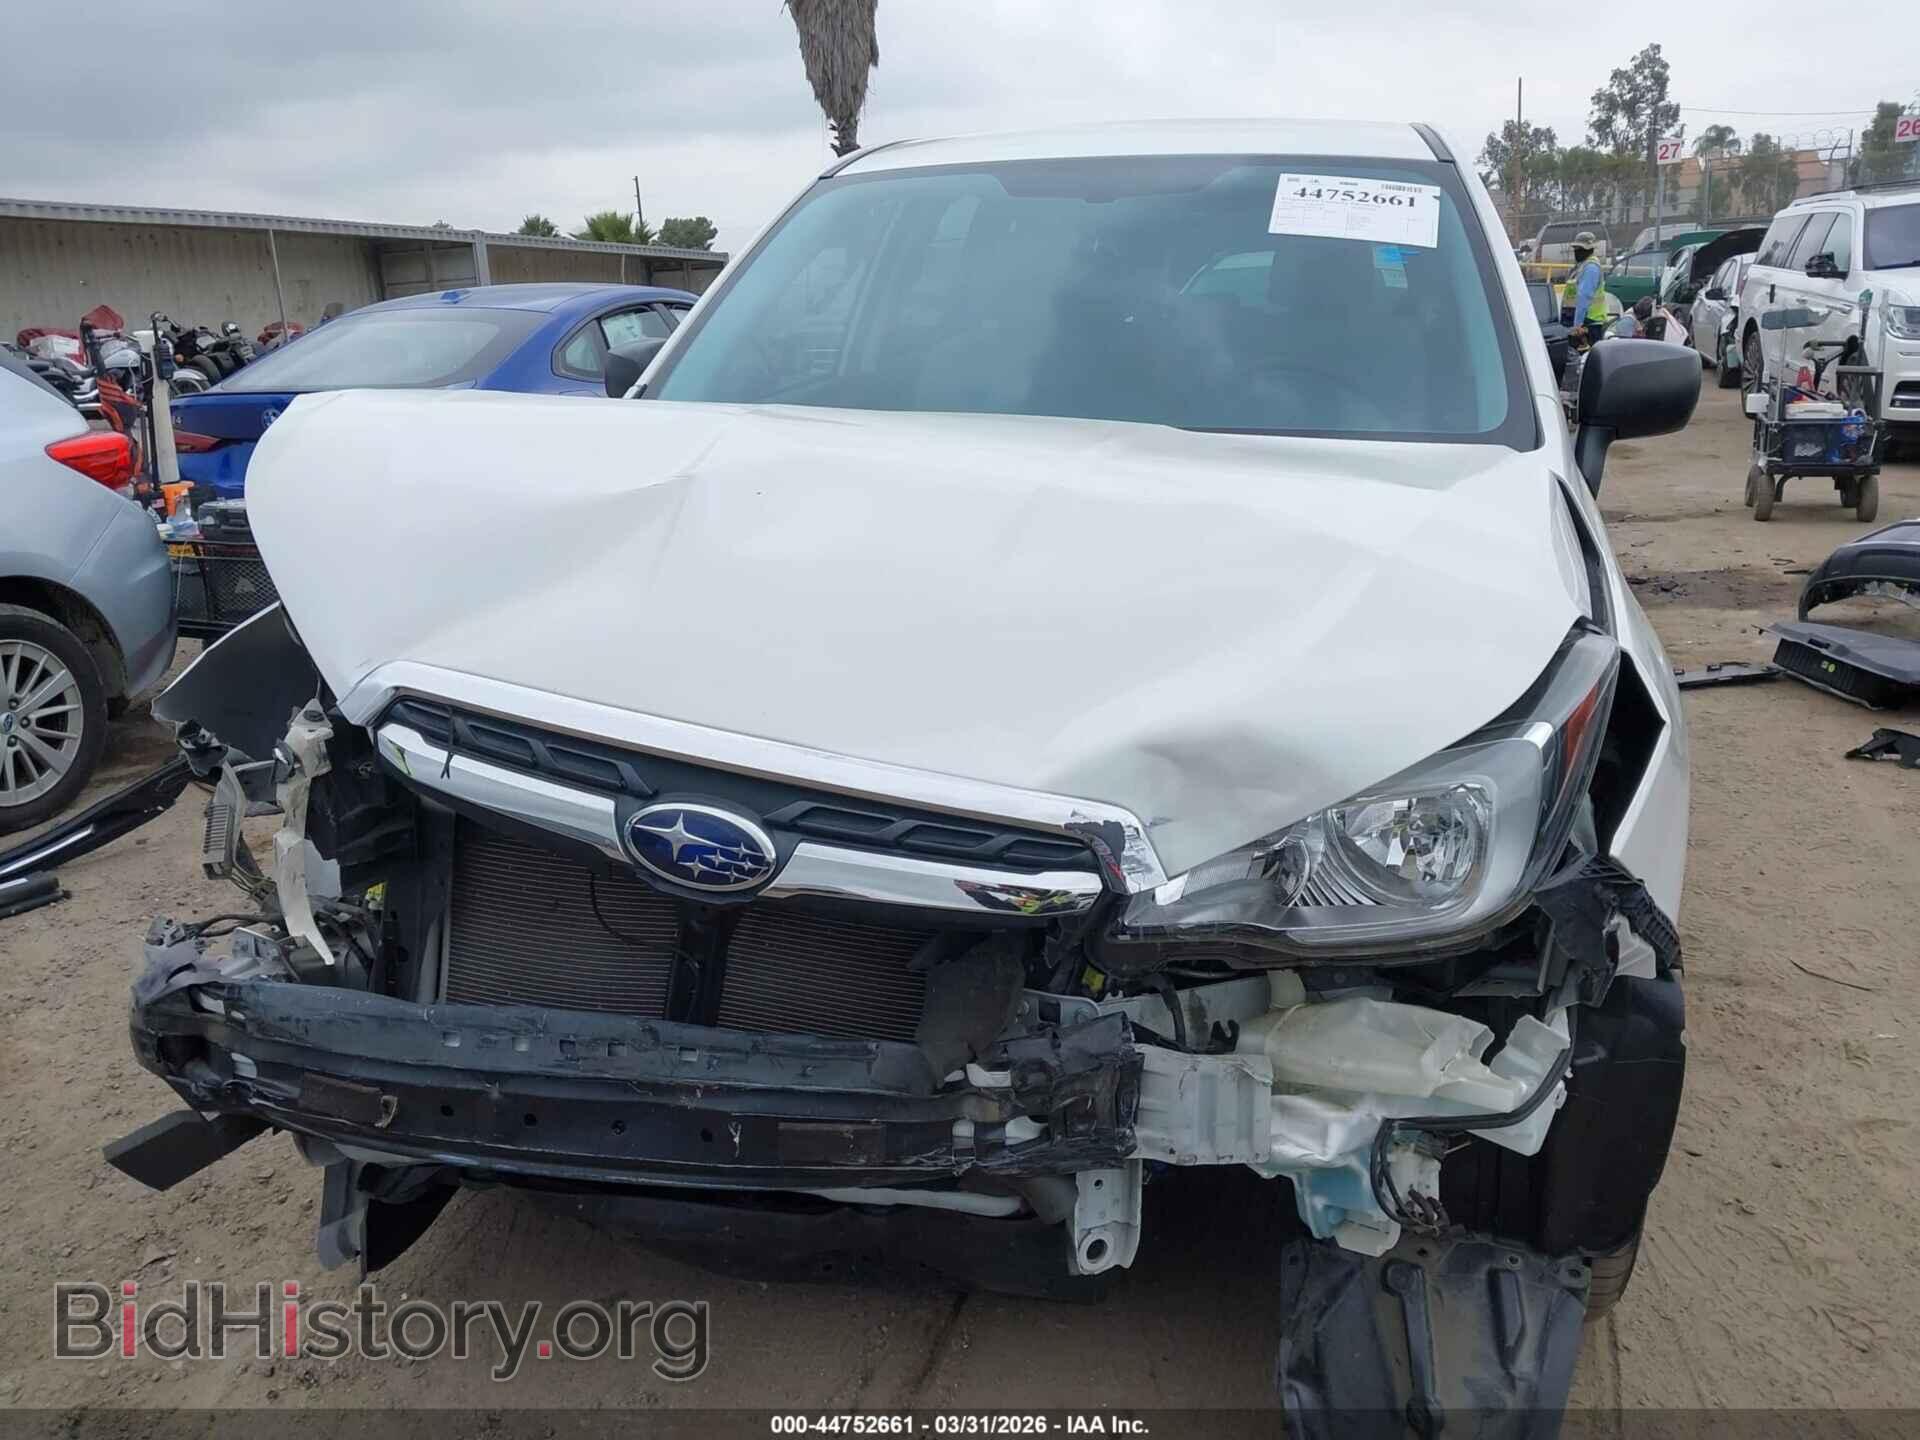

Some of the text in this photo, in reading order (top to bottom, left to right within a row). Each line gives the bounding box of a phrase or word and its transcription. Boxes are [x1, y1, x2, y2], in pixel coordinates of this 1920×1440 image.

[1898, 119, 1920, 138] 26
[1658, 142, 1681, 161] 27
[1292, 186, 1416, 208] 44752661
